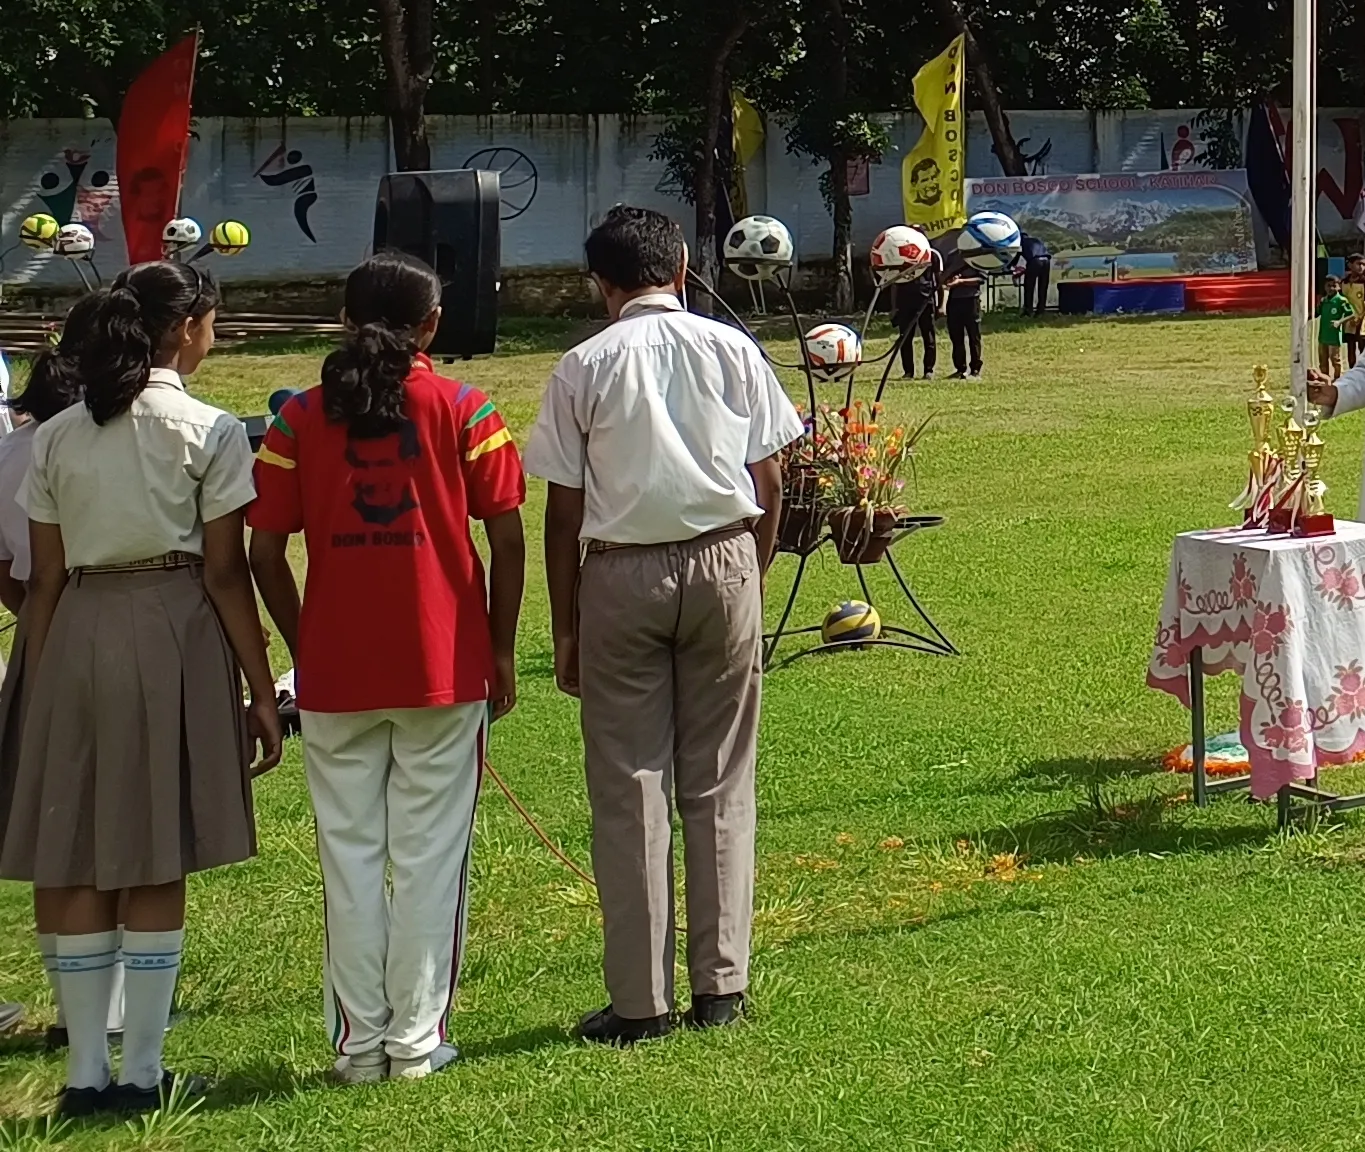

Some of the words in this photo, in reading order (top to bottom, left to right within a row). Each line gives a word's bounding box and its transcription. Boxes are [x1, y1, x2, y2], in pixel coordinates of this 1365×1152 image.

[971, 182, 1007, 195] DON
[1013, 180, 1070, 194] BOSCO
[1149, 174, 1215, 188] KATIHAR
[331, 532, 366, 548] DON
[371, 530, 425, 547] BOSCO
